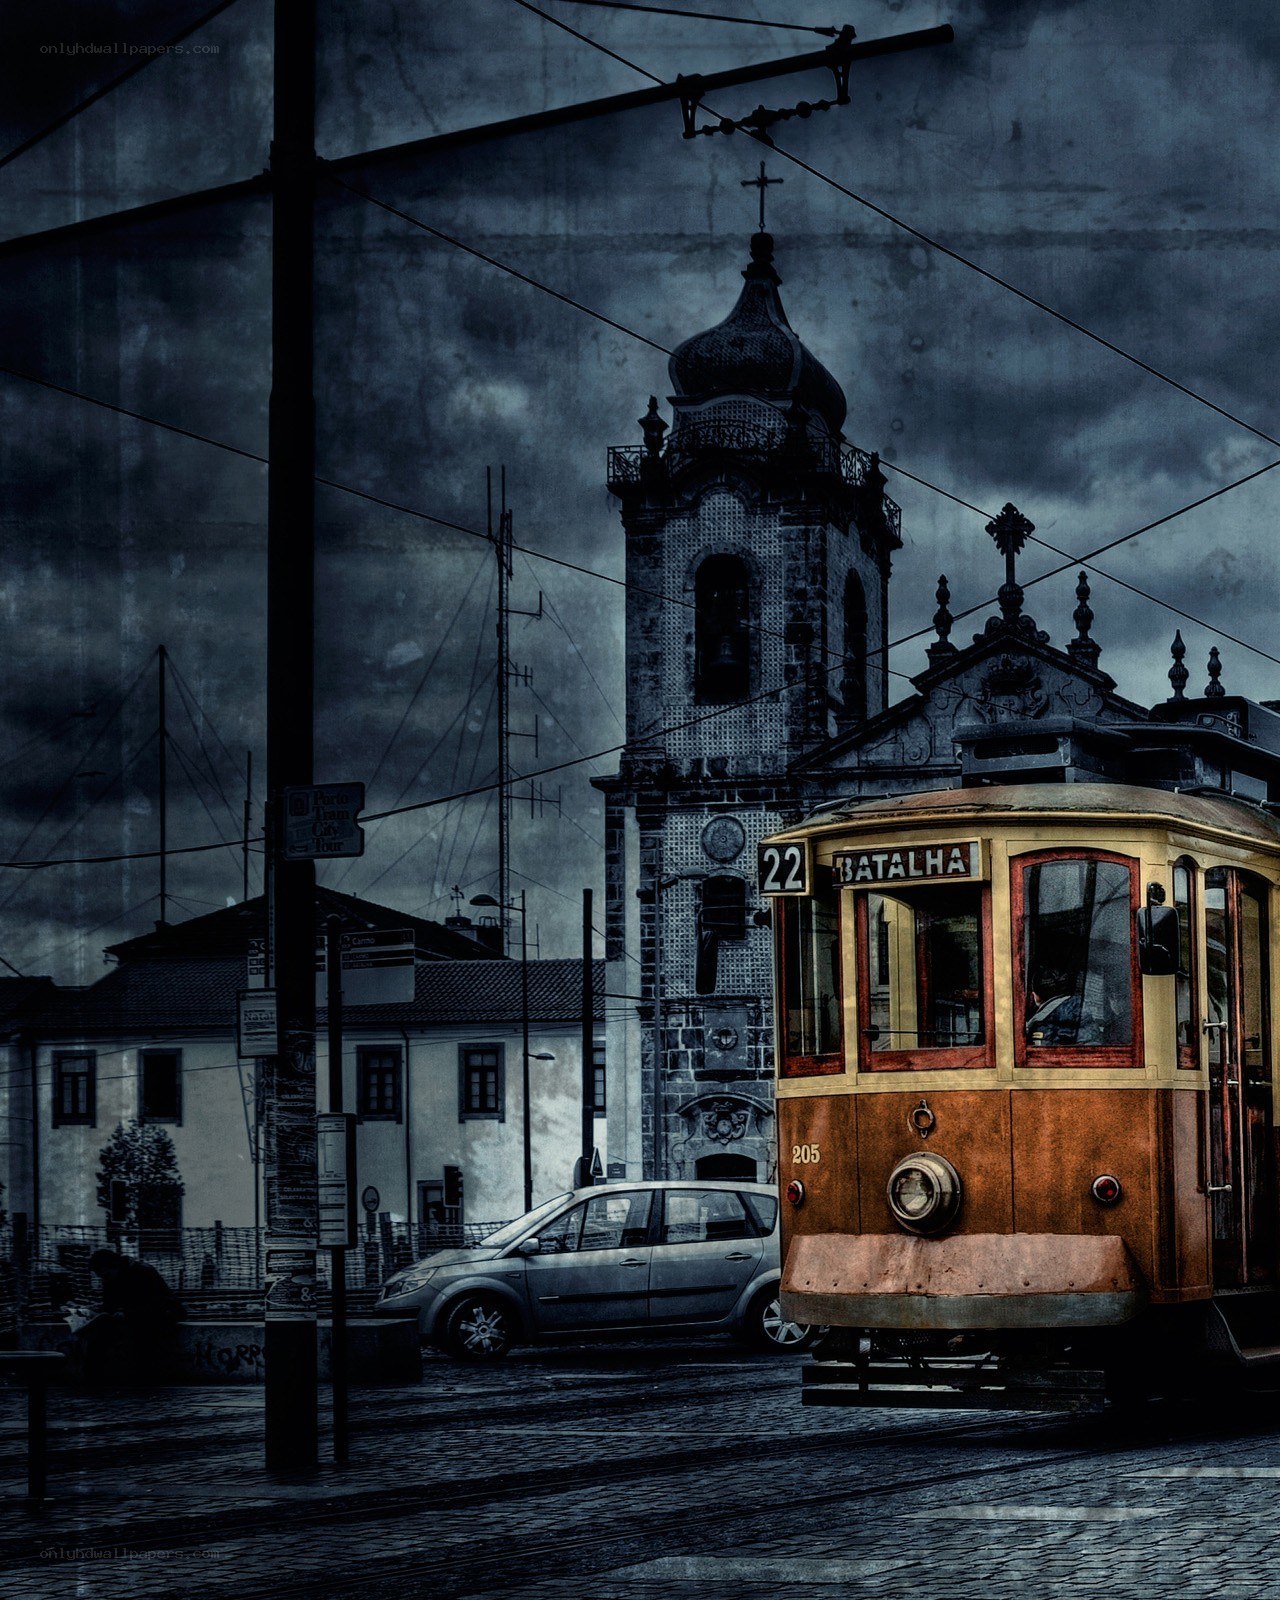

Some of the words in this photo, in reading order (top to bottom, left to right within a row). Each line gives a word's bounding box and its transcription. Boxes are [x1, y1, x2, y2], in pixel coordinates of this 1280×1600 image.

[312, 790, 349, 805] Porto
[312, 806, 350, 821] Tram
[312, 821, 337, 837] City
[312, 837, 345, 853] Tour
[763, 846, 803, 890] 22
[840, 847, 966, 883] BATALHA
[792, 1143, 820, 1164] 205
